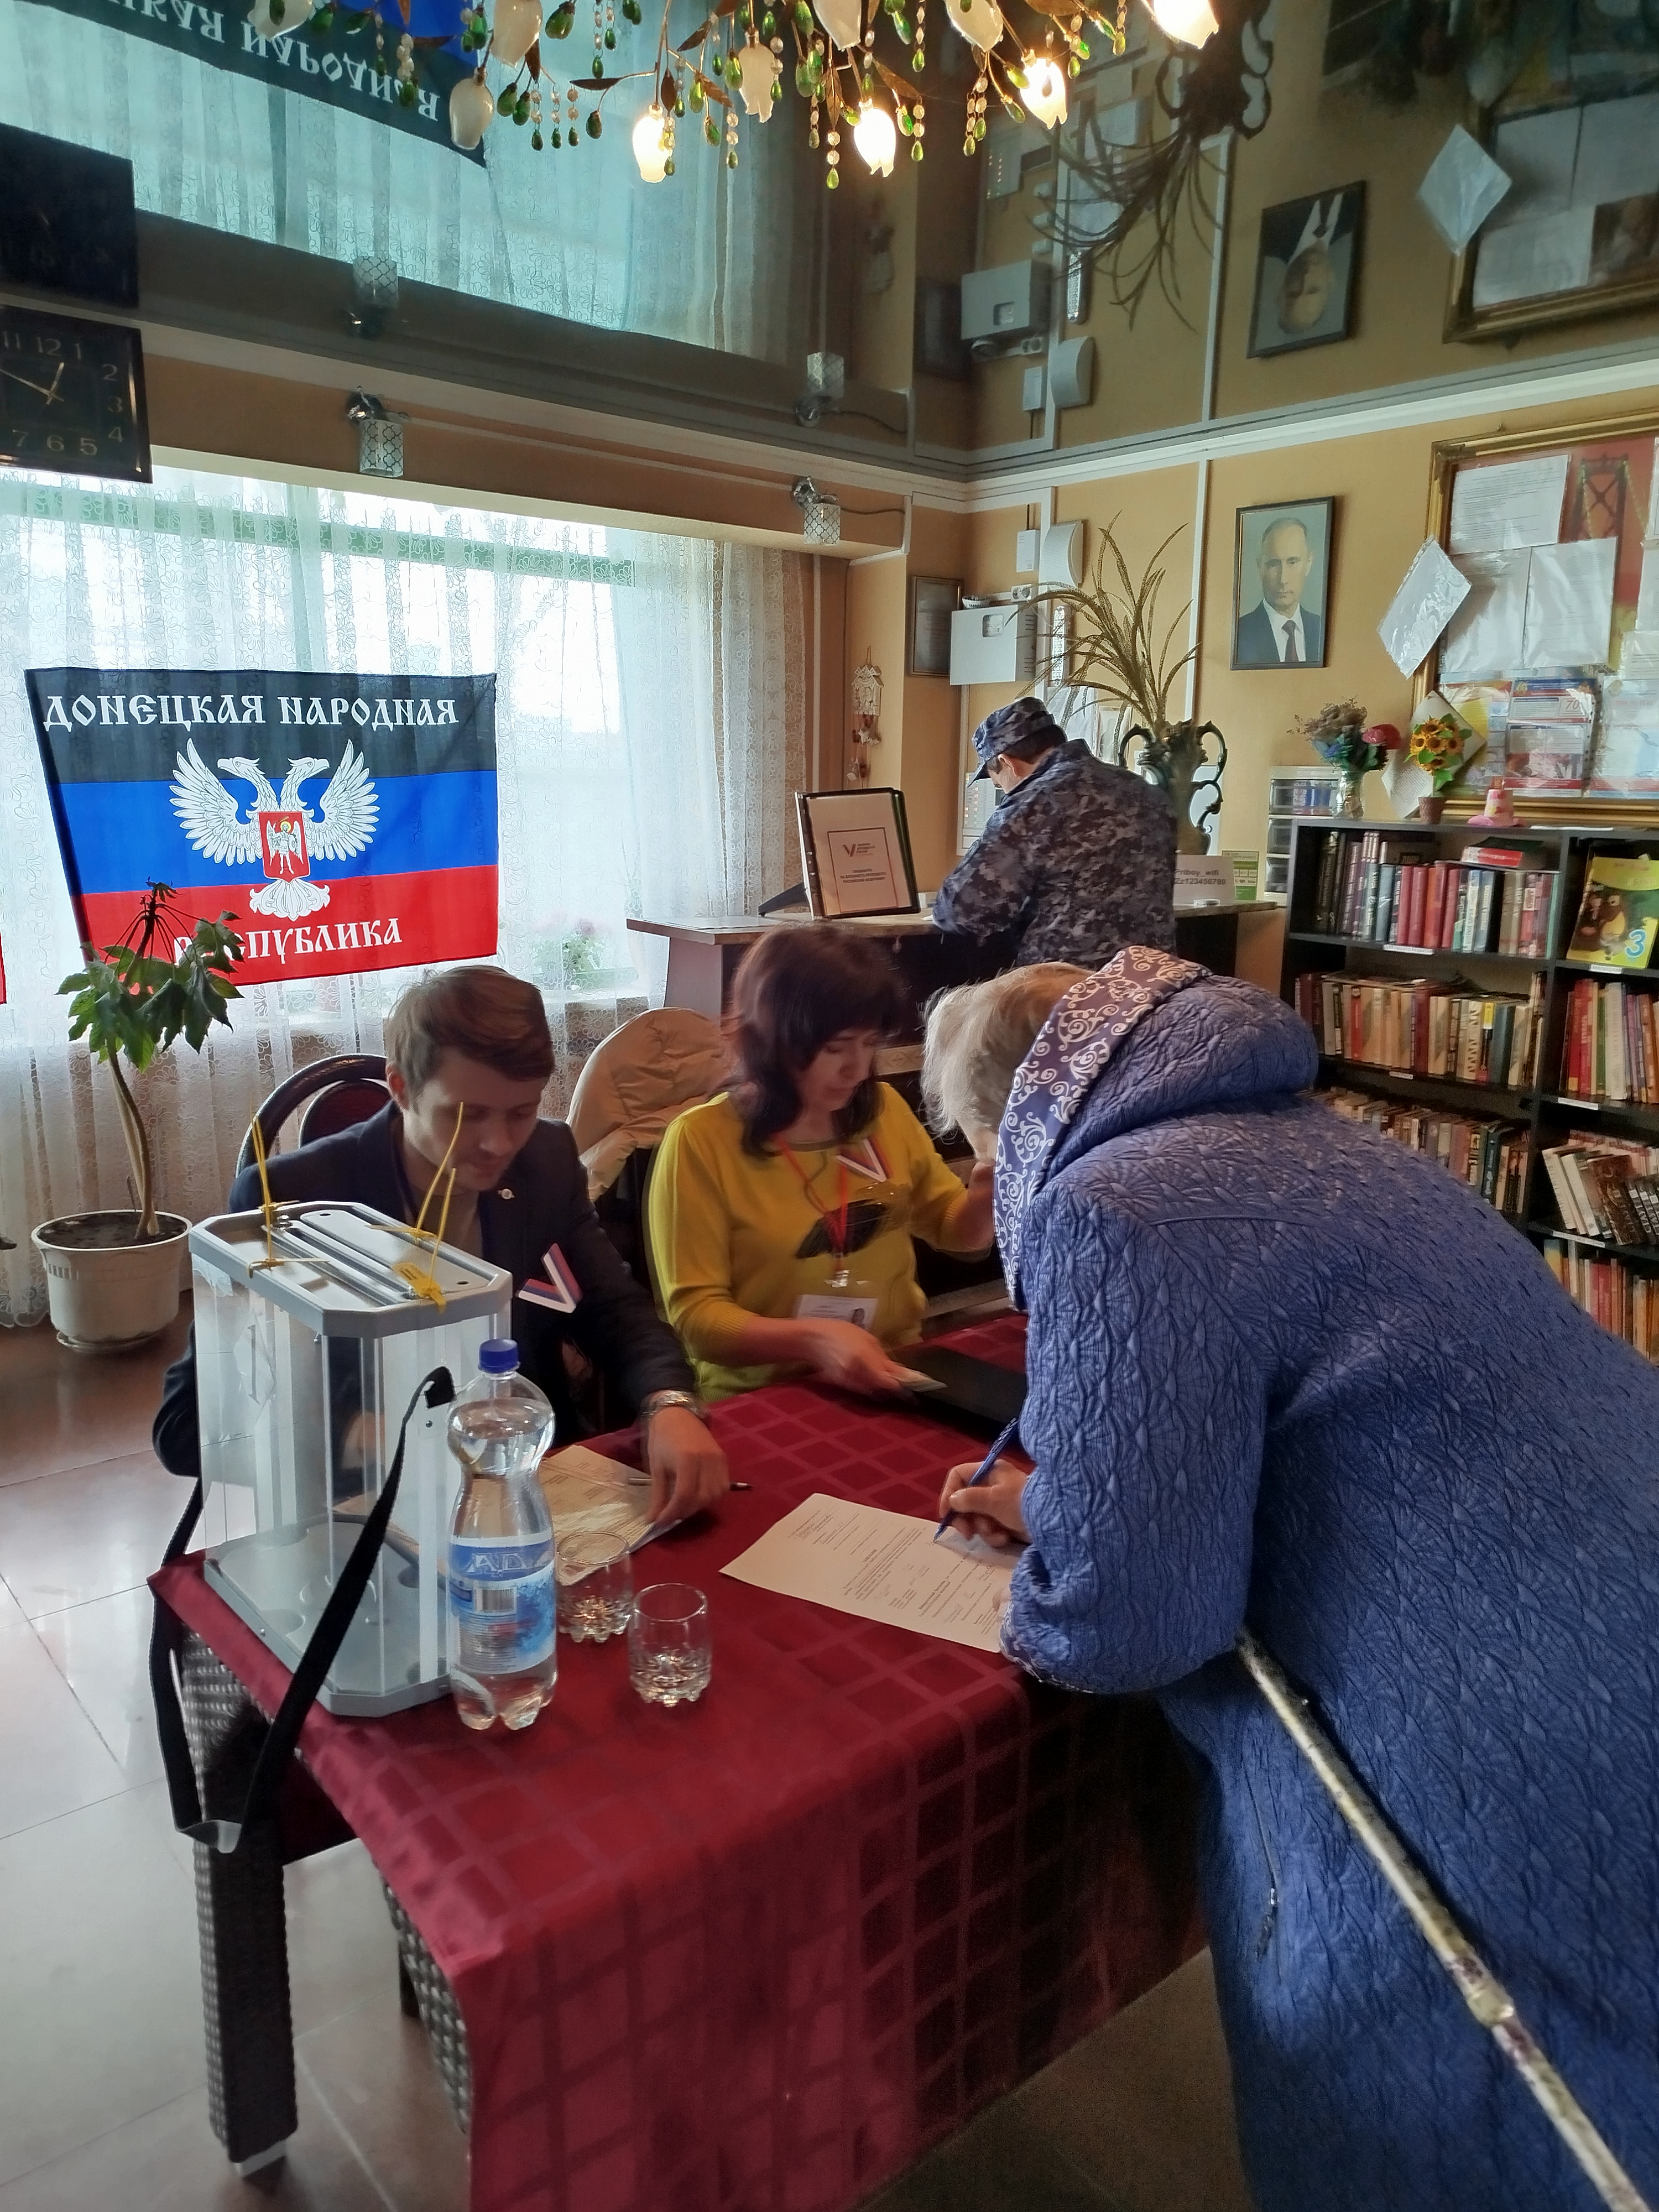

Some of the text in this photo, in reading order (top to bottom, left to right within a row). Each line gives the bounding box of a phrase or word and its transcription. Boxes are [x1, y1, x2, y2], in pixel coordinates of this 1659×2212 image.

[4, 331, 20, 349] 11
[35, 337, 61, 356] 12
[75, 343, 82, 359] 1
[102, 364, 118, 381] 2
[107, 396, 123, 413] 3
[12, 429, 29, 447] 7
[46, 435, 64, 451] 6
[108, 426, 124, 442] 4
[80, 437, 97, 455] 5
[43, 695, 459, 732] ДОНЕЦКАЯ НАРОДНАЯ
[174, 917, 403, 966] РПУБЛИКА
[1625, 929, 1647, 958] 3
